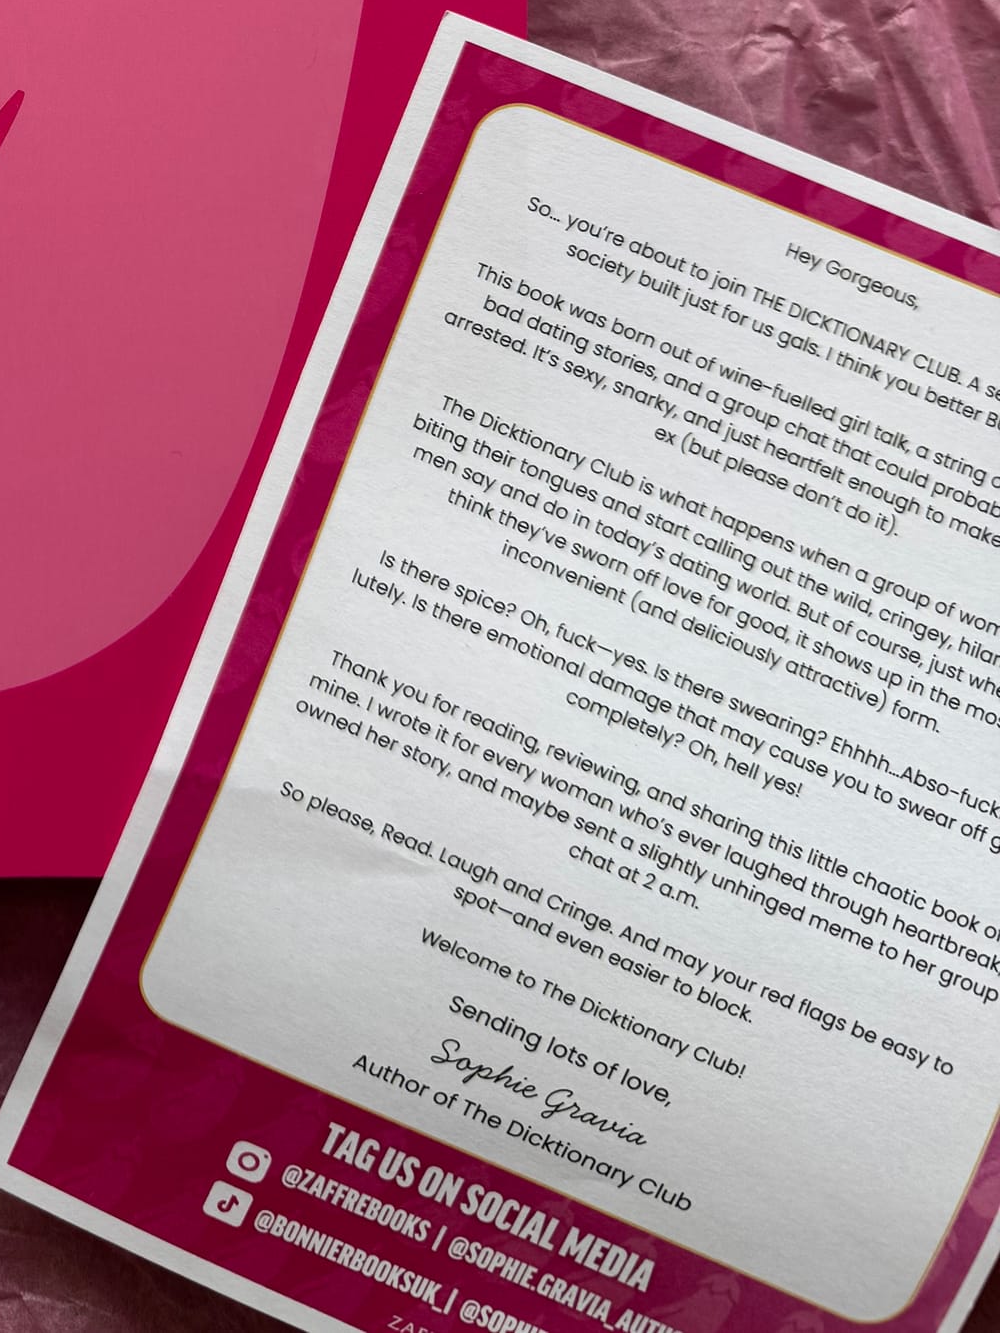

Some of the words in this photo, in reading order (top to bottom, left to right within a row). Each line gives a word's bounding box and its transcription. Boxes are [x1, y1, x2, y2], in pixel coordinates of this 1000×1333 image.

[564, 213, 627, 248] you're
[628, 240, 688, 274] about
[689, 261, 710, 282] to
[707, 270, 749, 298] join
[752, 286, 788, 313] THE
[786, 301, 912, 362] DICKTIONARY
[912, 353, 964, 386] CLUB.
[965, 375, 982, 393] A
[785, 242, 824, 272] Hey
[825, 259, 919, 311] Gorgeous,
[653, 427, 678, 447] ex
[680, 431, 725, 465] (but
[722, 455, 792, 491] please
[792, 482, 845, 514] don't
[844, 503, 874, 525] do
[873, 512, 899, 537] it).
[501, 538, 628, 606] inconvenient
[630, 589, 681, 627] (and
[680, 615, 783, 671] deliciously
[785, 659, 888, 713] attractive)
[891, 698, 941, 734] form.
[565, 691, 687, 749] completely?
[688, 739, 719, 767] Oh,
[723, 751, 762, 781] hell
[761, 770, 804, 799] yes!
[279, 780, 305, 803] So
[305, 795, 375, 836] please,
[380, 822, 434, 860] Read.
[438, 846, 499, 887] Laugh
[502, 877, 545, 905] and
[546, 893, 614, 936] Cringe.
[617, 925, 662, 954] And
[662, 944, 710, 977] may
[709, 964, 759, 993] your
[759, 985, 796, 1010] red
[797, 997, 848, 1032] flags
[849, 1019, 878, 1044] be
[880, 1036, 931, 1070] easy
[933, 1055, 954, 1076] to
[568, 844, 616, 874] chat
[617, 865, 642, 885] at
[641, 872, 658, 891] 2
[658, 882, 700, 910] a.m.
[421, 927, 513, 980] Welcome
[515, 969, 537, 990] to
[542, 978, 577, 1007] The
[579, 996, 691, 1058] Dicktionary
[692, 1045, 747, 1080] Club!
[555, 930, 605, 961] even
[607, 952, 671, 986] easier
[672, 975, 694, 997] to
[696, 985, 752, 1024] block.
[430, 1038, 539, 1099] Sophie
[540, 1088, 648, 1146] Gravia
[448, 995, 543, 1053] Sending
[545, 1035, 589, 1069] lots
[592, 1060, 620, 1080] of
[619, 1067, 672, 1108] love,
[351, 1054, 431, 1098] Author
[432, 1091, 460, 1110] of
[463, 1098, 503, 1130] The
[505, 1119, 636, 1189] Dicktionary
[638, 1177, 692, 1212] Club
[281, 1164, 432, 1242] @ZAFFREBOOKS
[321, 1121, 381, 1172] TAG
[378, 1147, 421, 1188] US
[417, 1165, 465, 1208] ON
[460, 1184, 560, 1251] SOCIAL
[558, 1226, 655, 1293] MEDIA
[253, 1209, 443, 1313] @BONNIERBOOKSUK_
